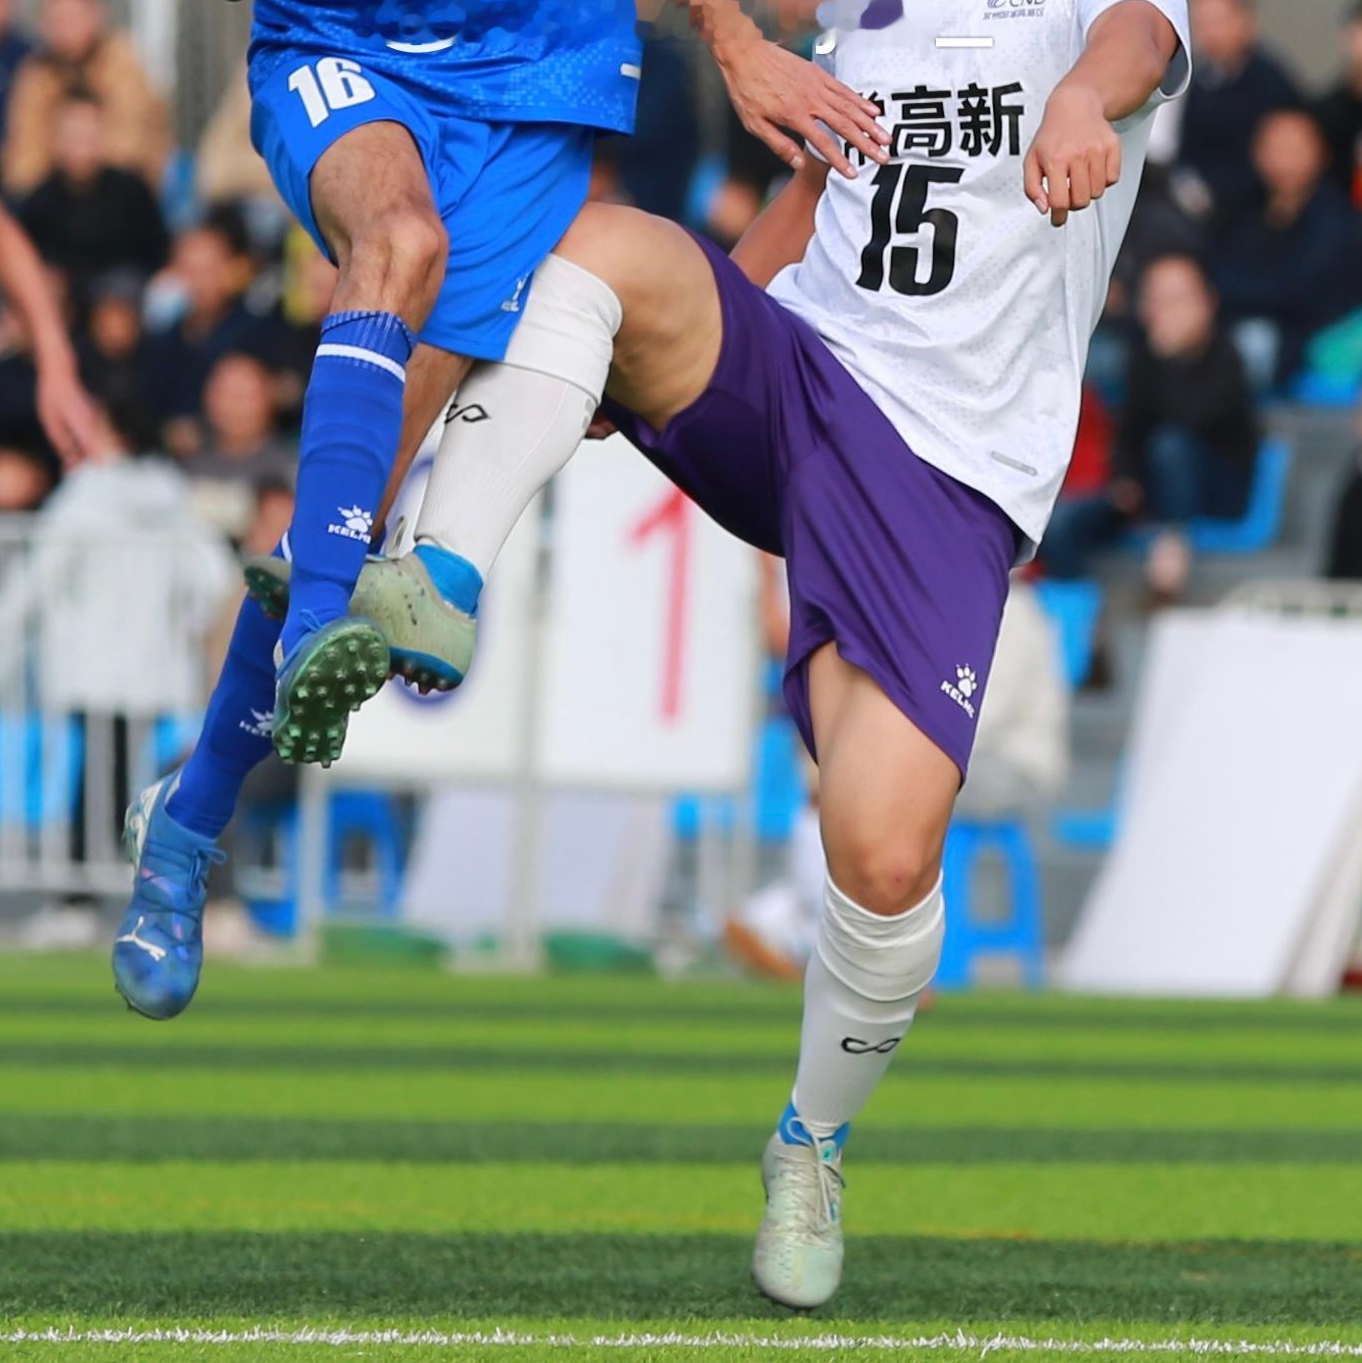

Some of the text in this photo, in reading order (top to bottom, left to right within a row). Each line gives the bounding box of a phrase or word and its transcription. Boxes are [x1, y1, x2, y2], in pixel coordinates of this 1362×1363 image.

[288, 56, 376, 128] 16
[855, 163, 965, 296] 15
[328, 523, 372, 544] KELM
